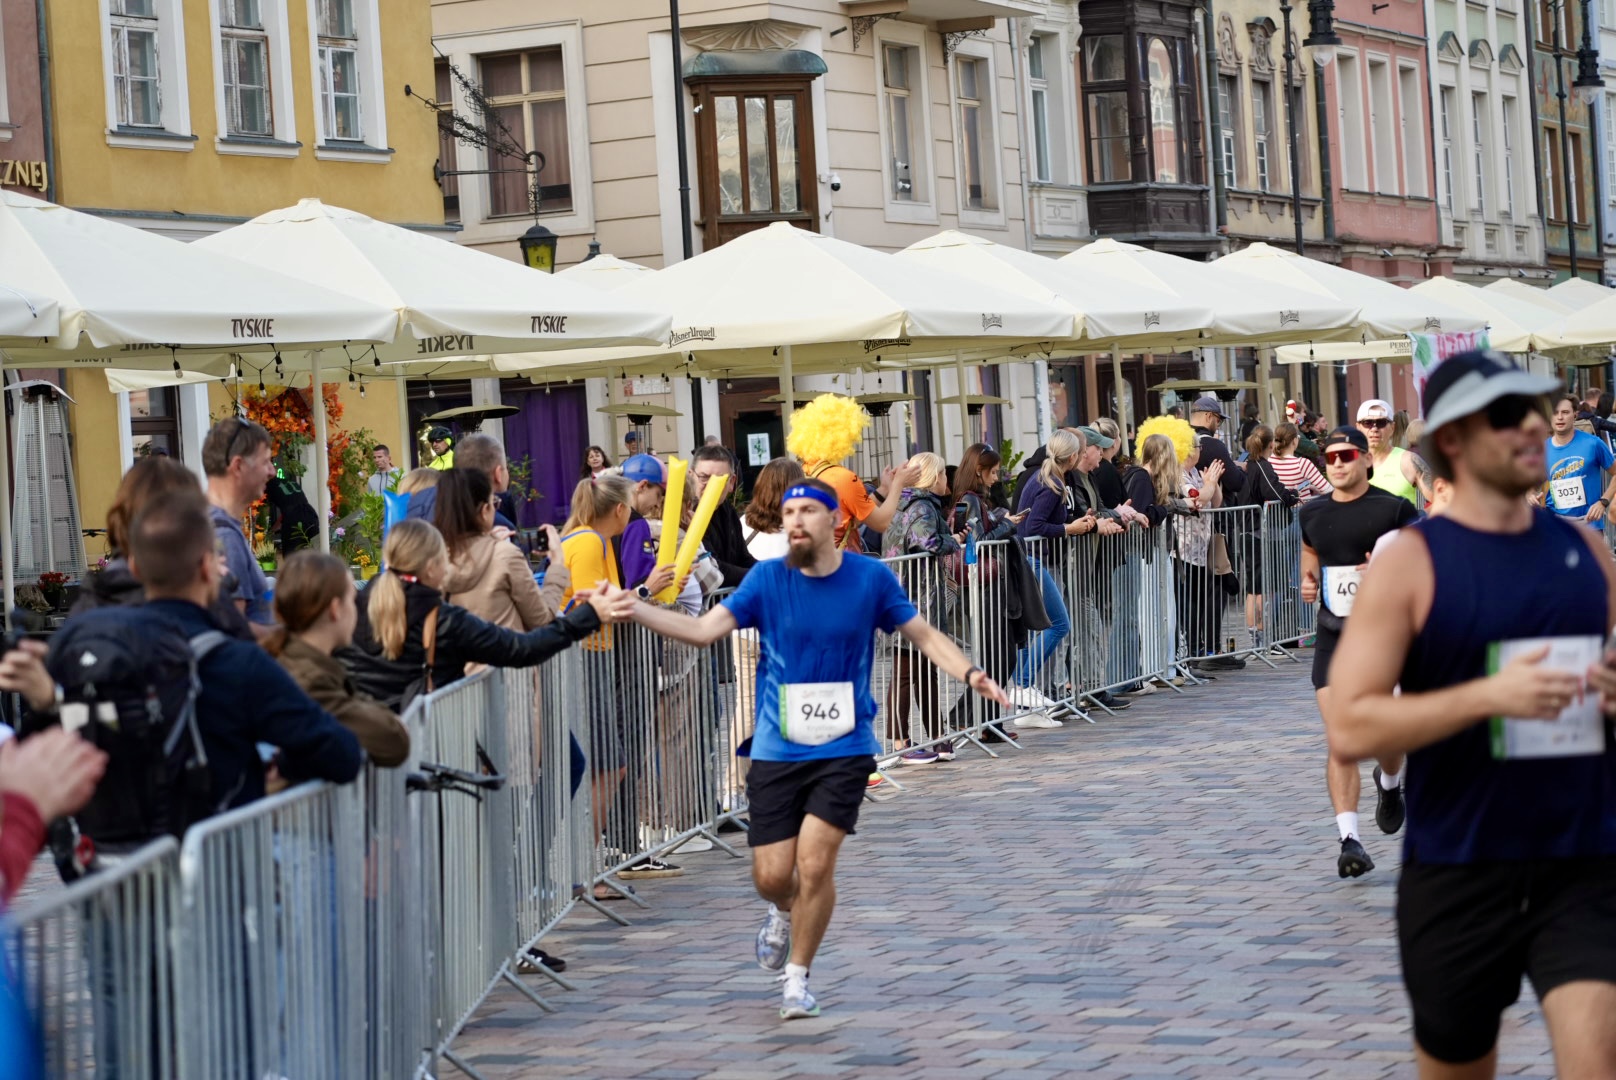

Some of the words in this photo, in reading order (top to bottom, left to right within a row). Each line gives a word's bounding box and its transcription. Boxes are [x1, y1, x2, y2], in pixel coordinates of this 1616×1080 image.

[0, 160, 48, 192] ZNEJ
[231, 319, 274, 338] TYSKIE
[531, 316, 568, 333] TYSKIE
[668, 330, 691, 349] Pilsner
[690, 326, 715, 341] Urquell
[1557, 486, 1579, 498] 3037
[1337, 581, 1358, 596] 40
[801, 702, 840, 721] 946
